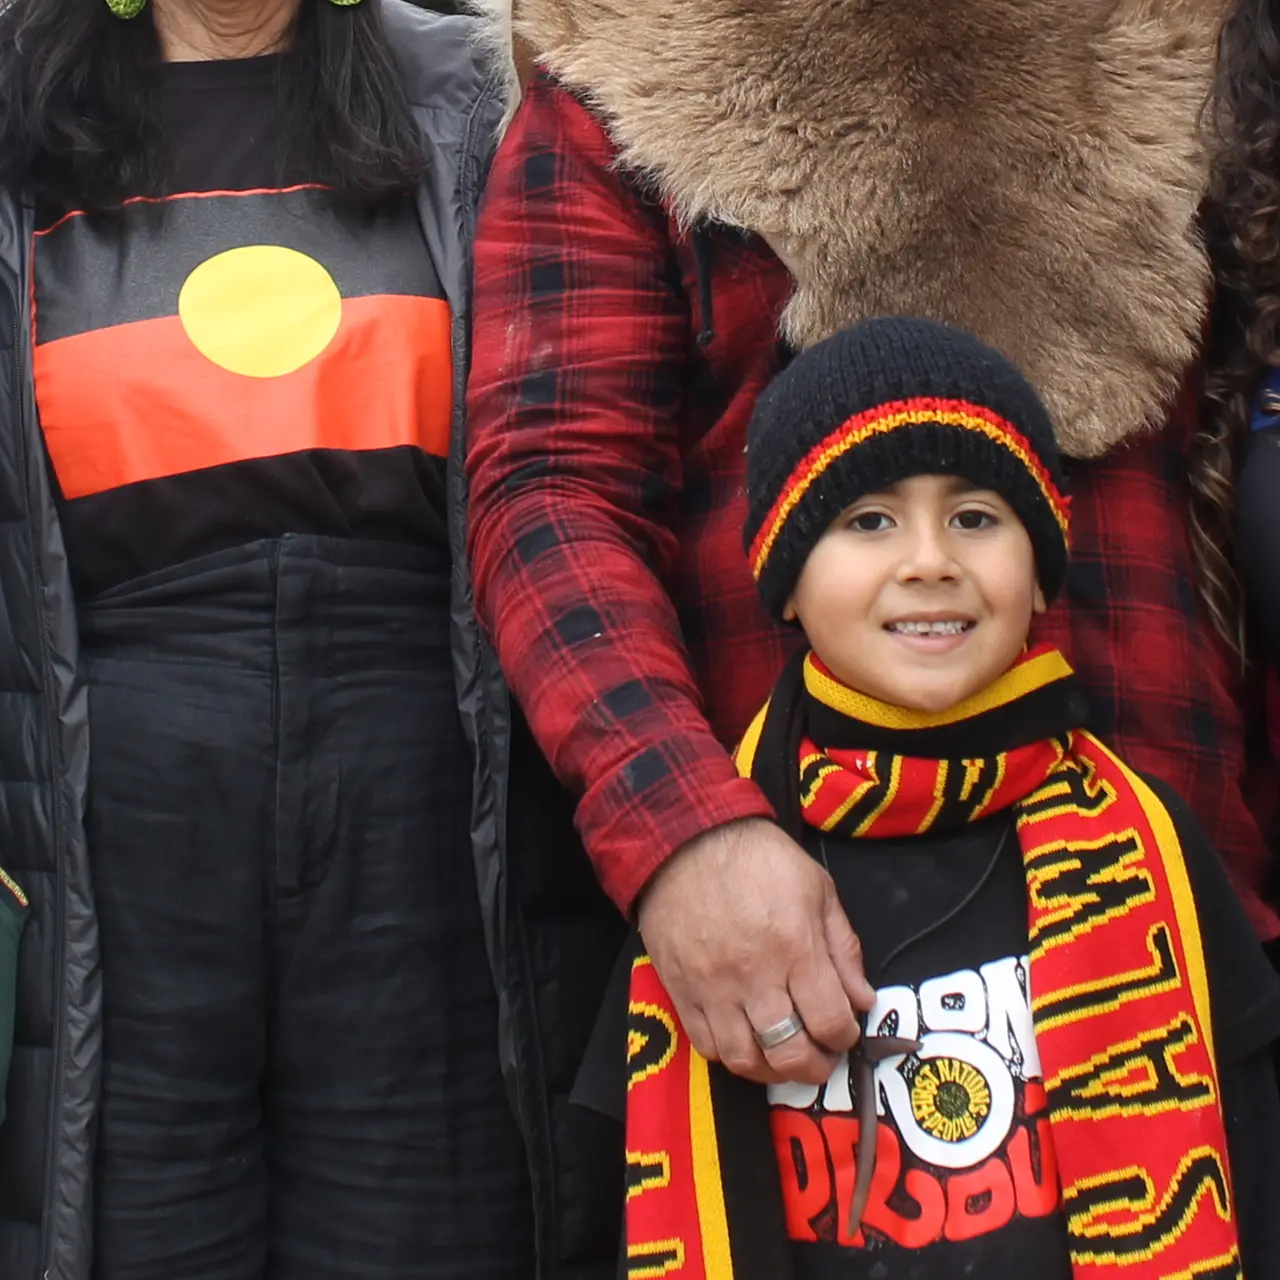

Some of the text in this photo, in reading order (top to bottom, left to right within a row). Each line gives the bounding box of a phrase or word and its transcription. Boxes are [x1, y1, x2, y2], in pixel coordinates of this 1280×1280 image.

[911, 1058, 990, 1120] FIRST NATIONS
[770, 1100, 1060, 1250] PROU
